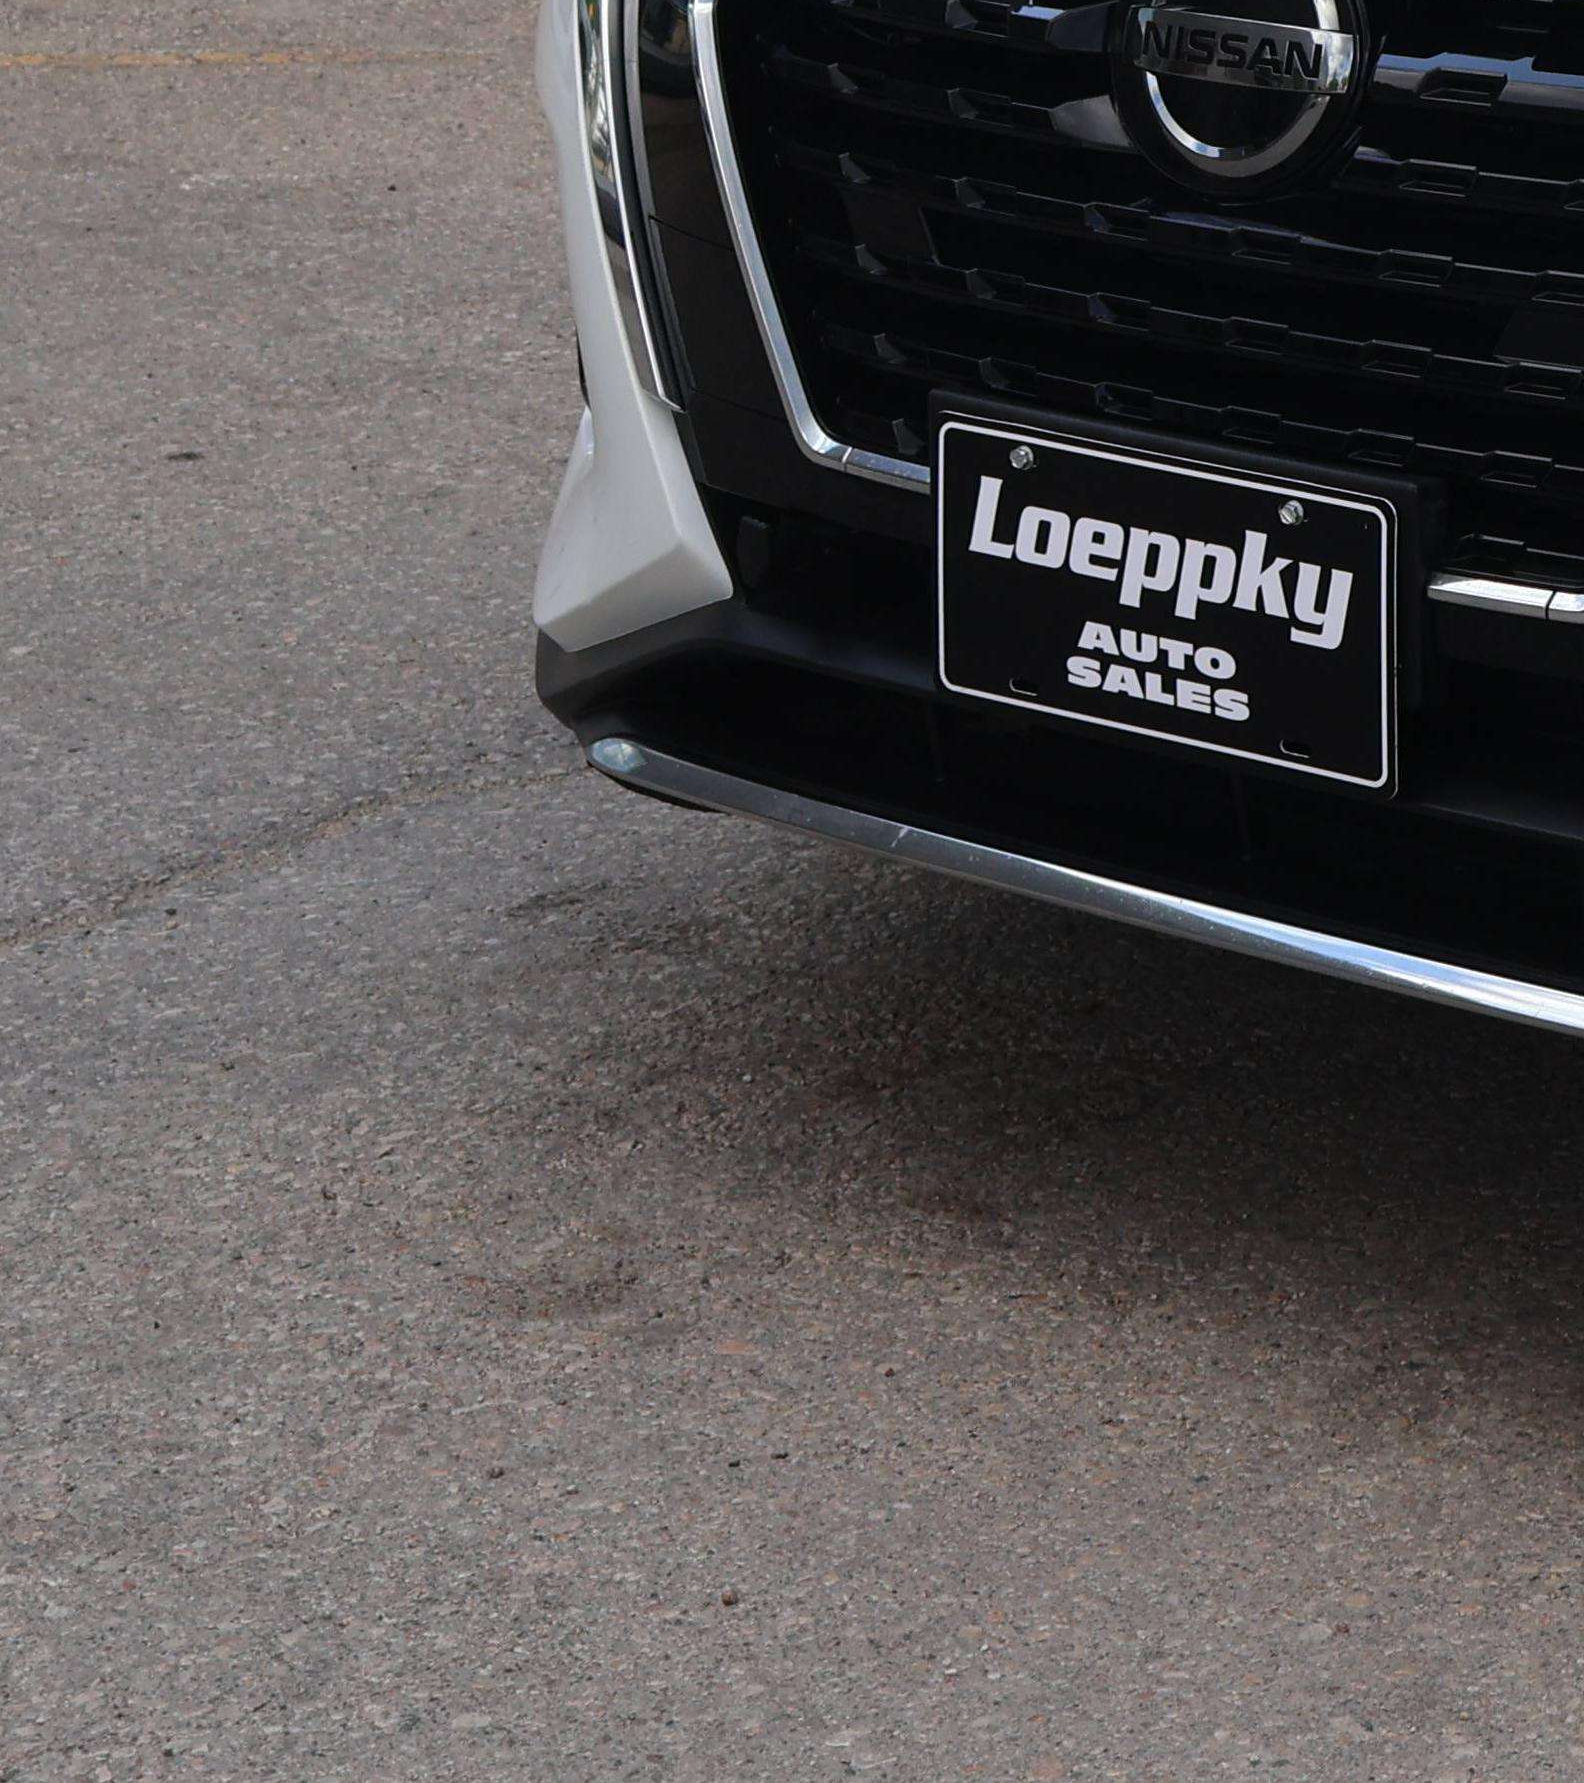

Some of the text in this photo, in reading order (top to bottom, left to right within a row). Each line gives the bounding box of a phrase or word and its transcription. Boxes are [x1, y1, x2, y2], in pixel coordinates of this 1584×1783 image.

[1142, 21, 1324, 81] NISSAN
[969, 475, 1354, 651] Loeppky
[1077, 620, 1237, 680] AUTO
[1066, 655, 1250, 722] SALES
